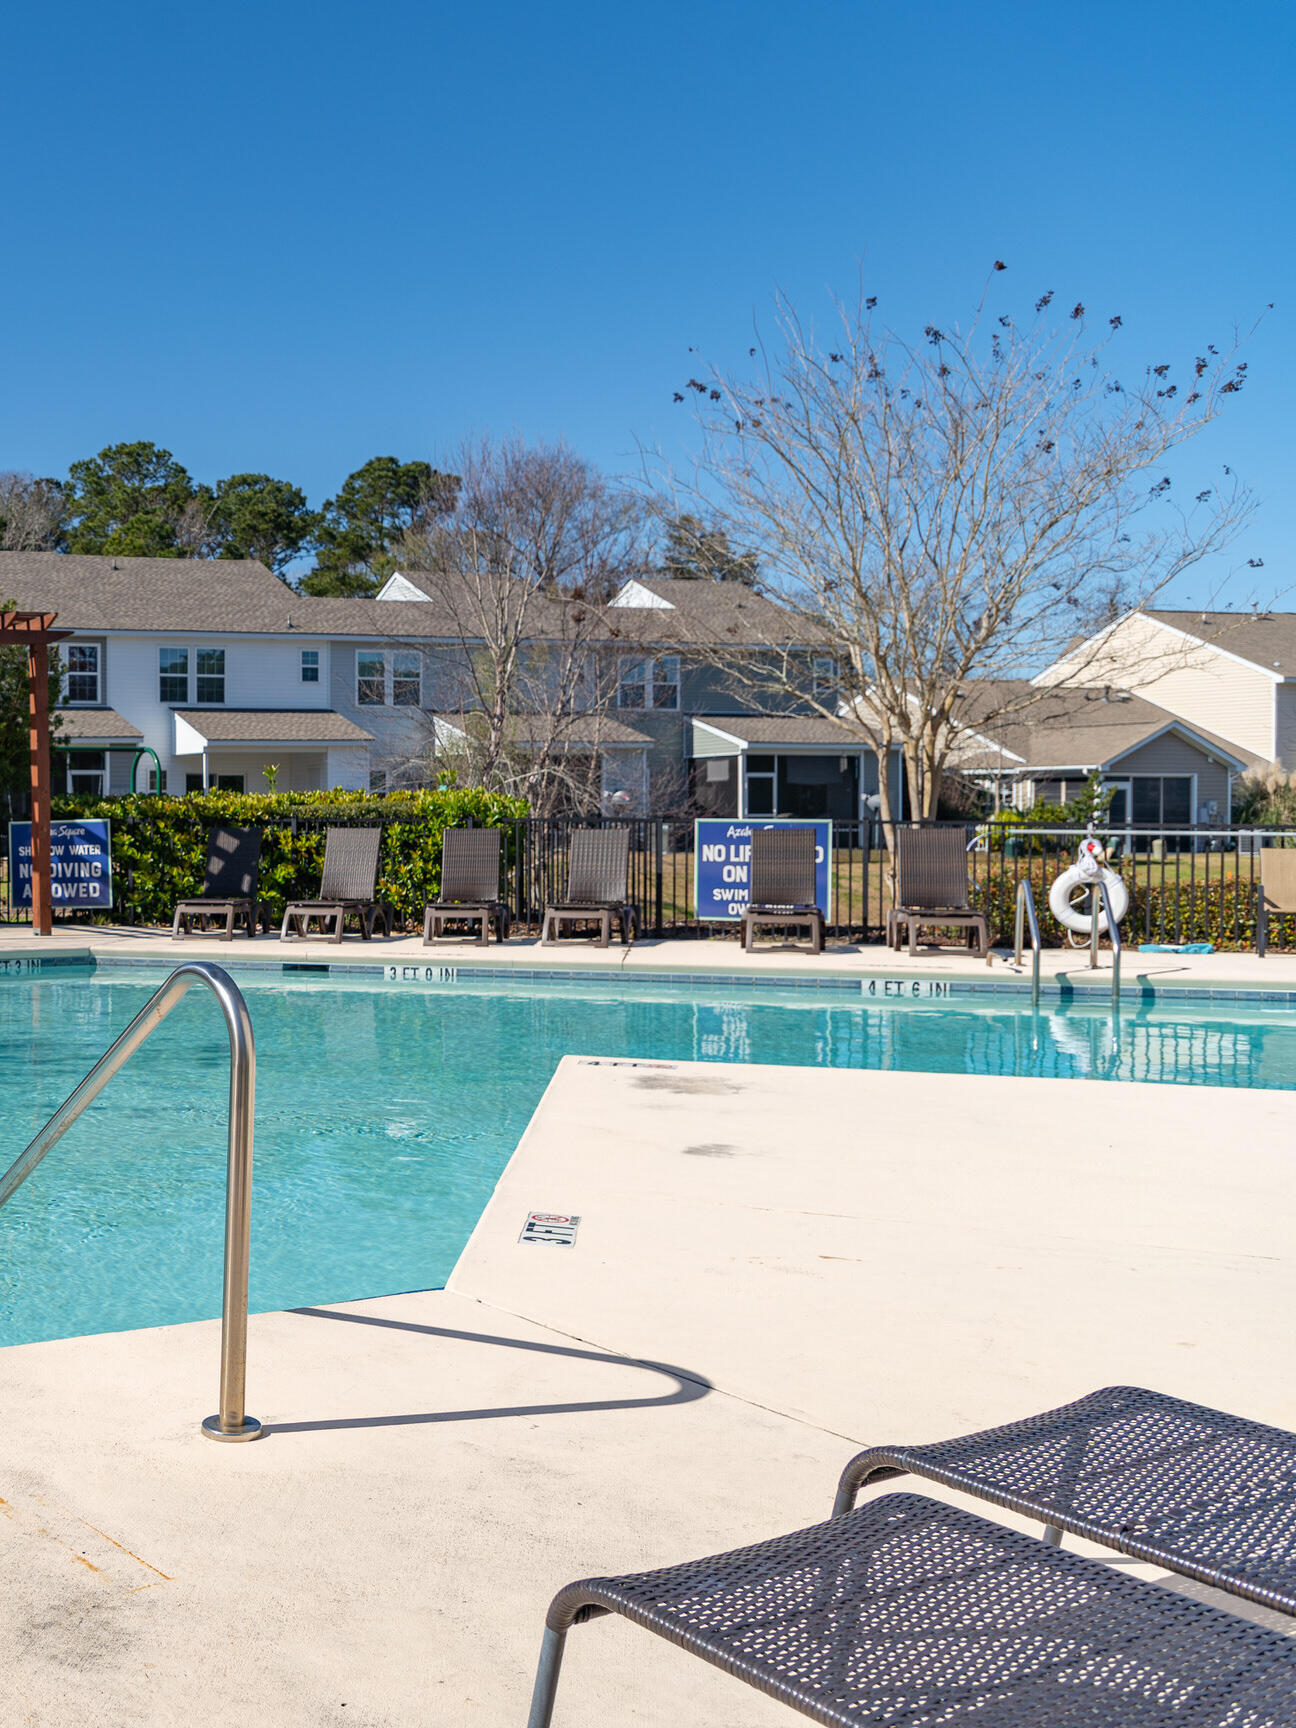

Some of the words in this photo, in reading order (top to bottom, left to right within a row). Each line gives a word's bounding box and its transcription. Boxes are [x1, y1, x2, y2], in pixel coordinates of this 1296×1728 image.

[58, 825, 85, 840] Square
[69, 844, 101, 856] WATER
[702, 844, 726, 862] NO
[722, 865, 748, 883] ON
[22, 882, 100, 899] AOWED
[712, 888, 749, 901] SWIM
[728, 903, 751, 915] OW
[526, 1221, 575, 1237] FT
